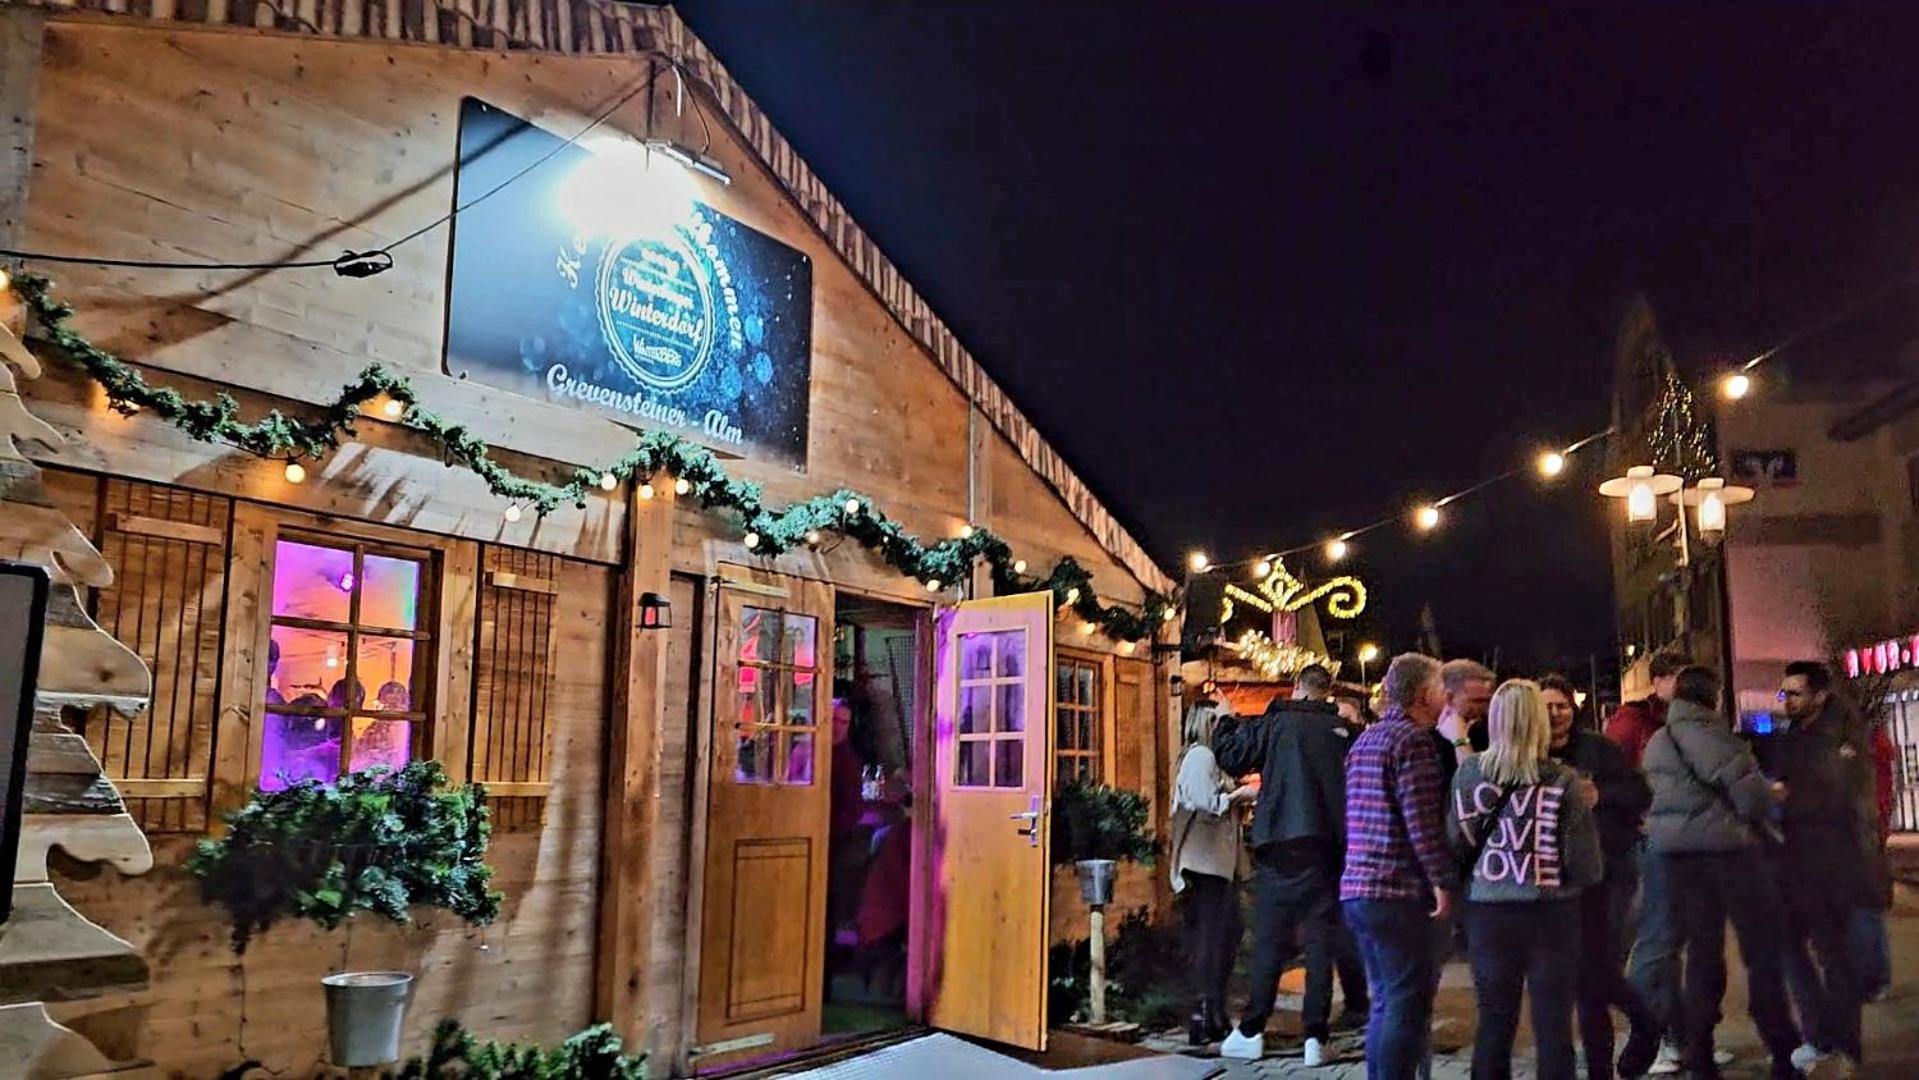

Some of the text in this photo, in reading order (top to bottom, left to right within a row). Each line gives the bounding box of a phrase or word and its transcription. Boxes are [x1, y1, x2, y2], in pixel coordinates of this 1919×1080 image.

[609, 287, 705, 347] Winterdorf
[546, 363, 687, 428] Grevensteiner
[704, 409, 744, 445] Alm
[1473, 849, 1561, 887] OVE
